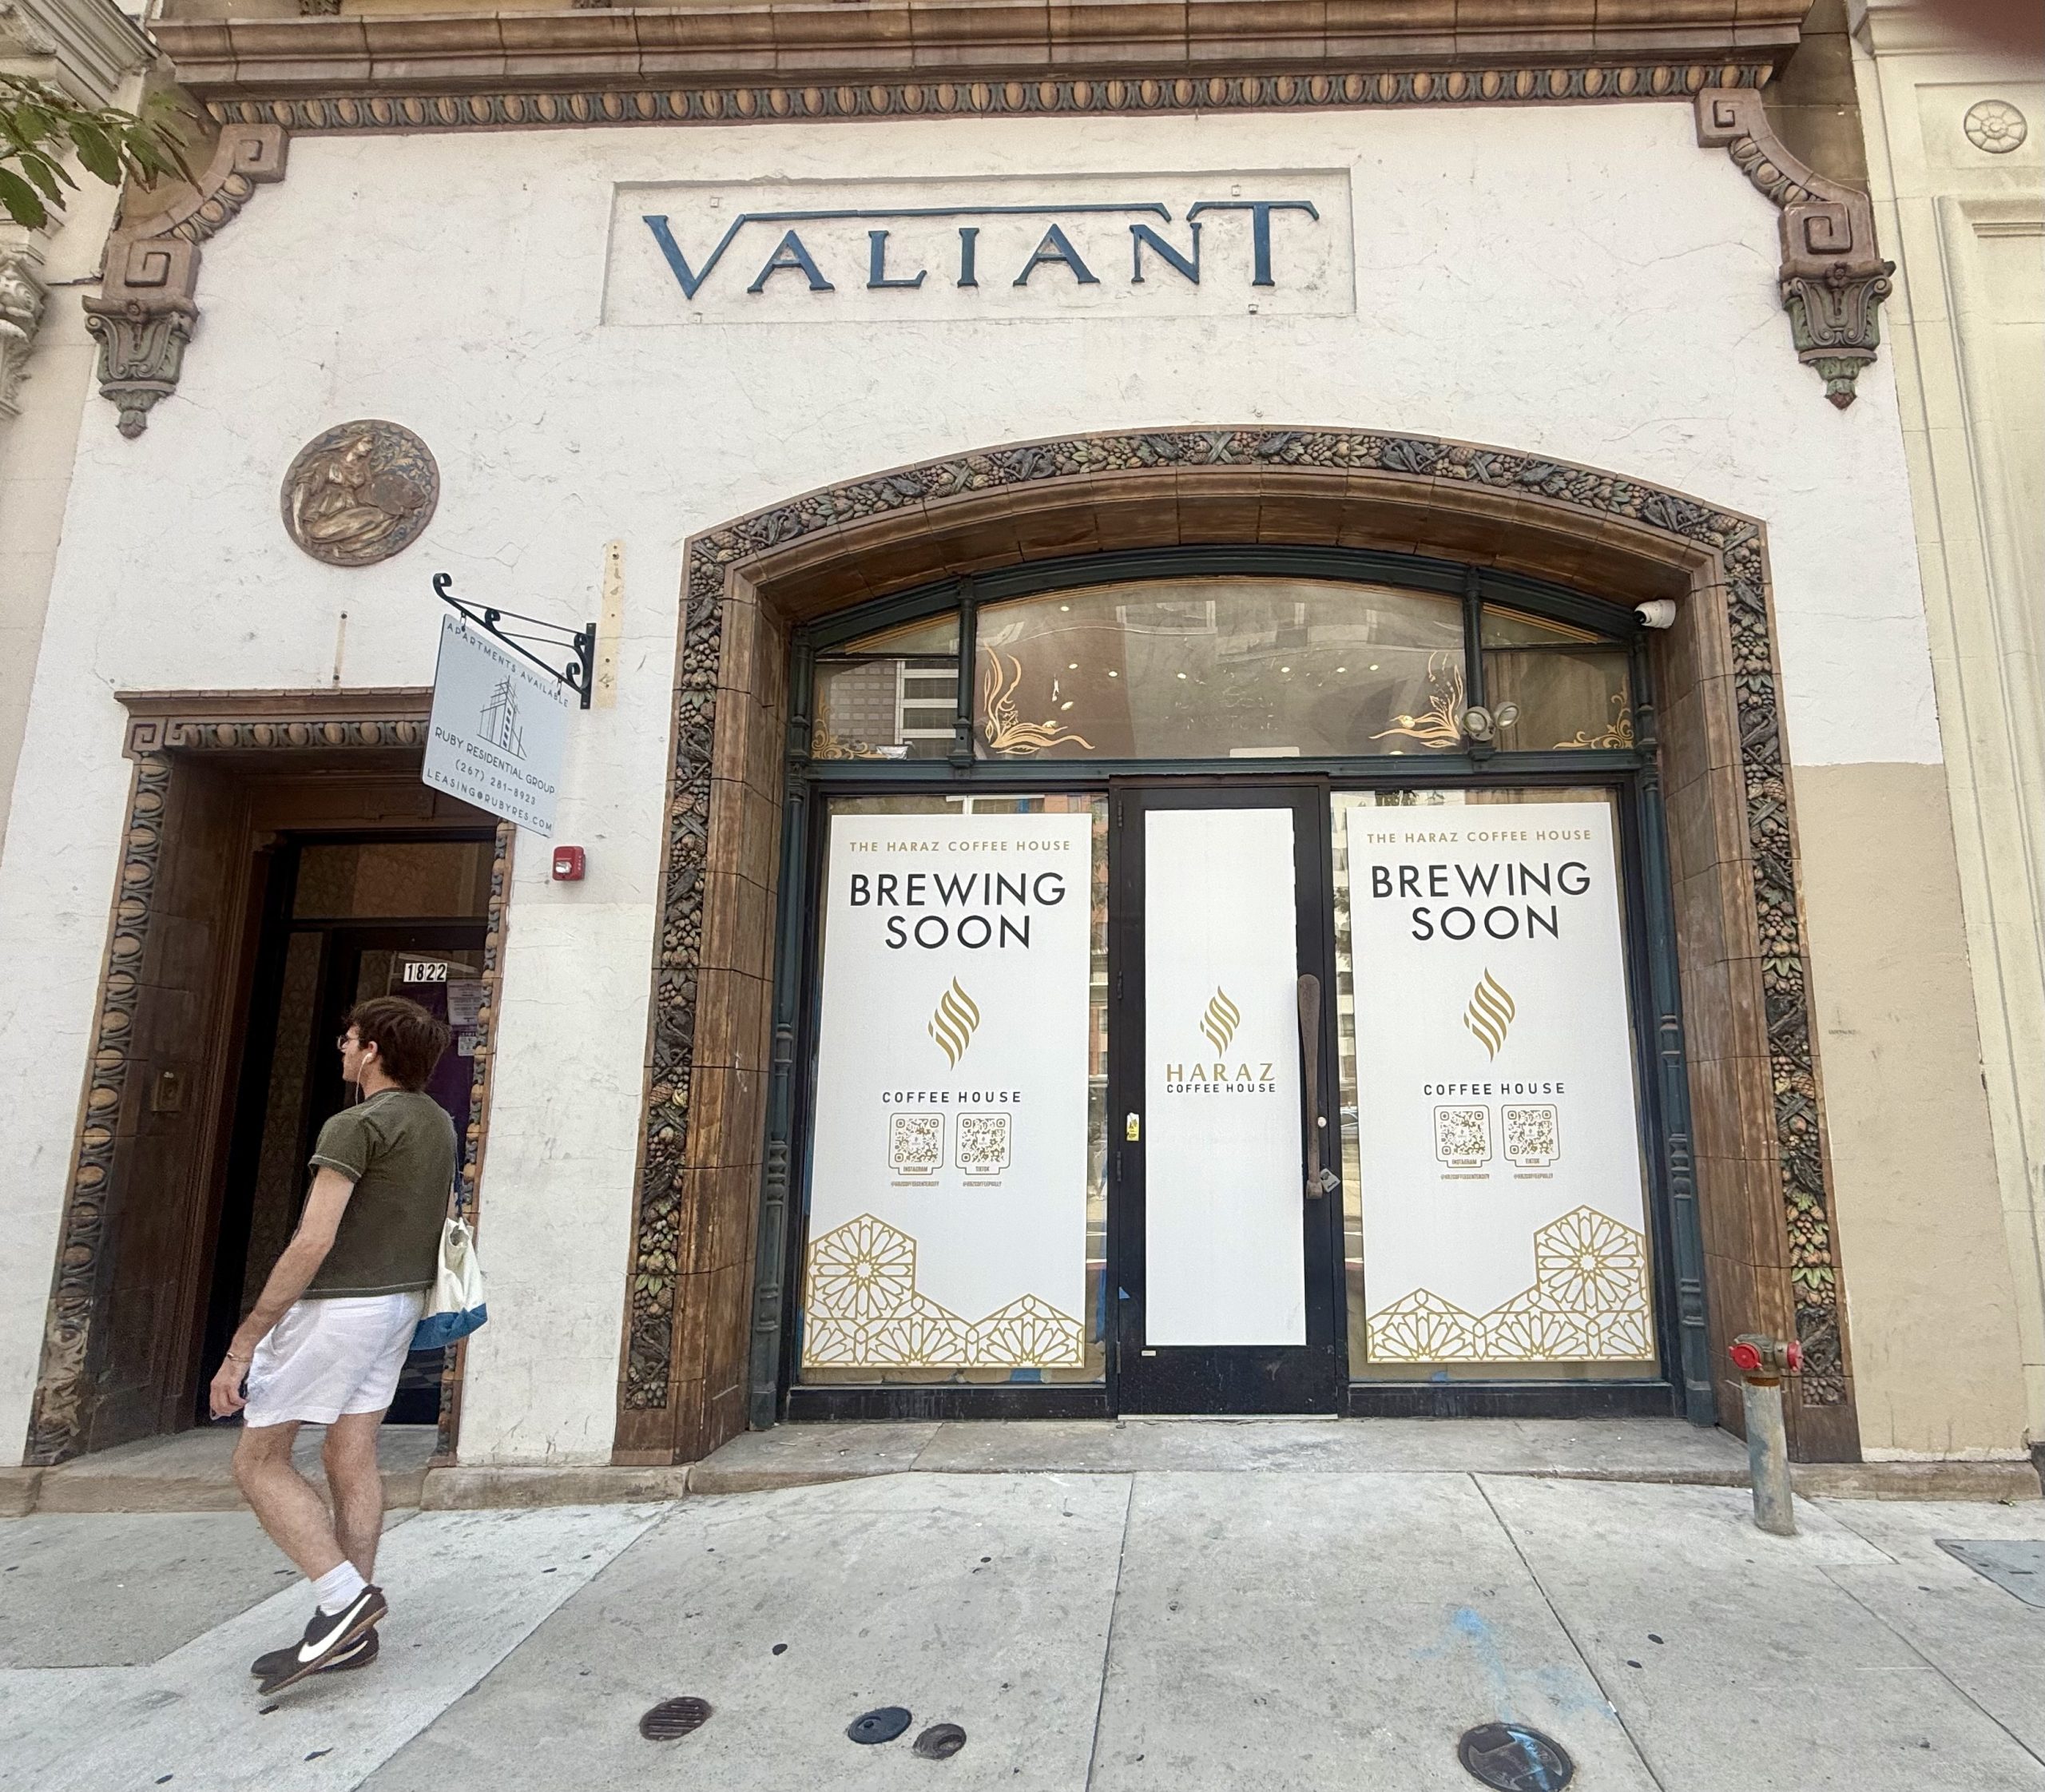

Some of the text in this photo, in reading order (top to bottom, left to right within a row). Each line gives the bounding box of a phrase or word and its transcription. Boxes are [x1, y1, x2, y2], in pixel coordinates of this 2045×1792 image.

[642, 201, 1320, 300] VALIANT
[447, 622, 569, 708] APARTMENTS AVAILABLE
[435, 727, 555, 794] RUBY RESIDENTIAL GROUP
[455, 759, 536, 805] (267) 281-8923
[850, 840, 1070, 852] THE HARAZ COFFEE HOUSE
[1368, 829, 1591, 844] THE HARAZ COFFEE HOUSE
[850, 872, 1066, 908] BREWING
[1372, 861, 1590, 899] BREWING
[884, 913, 1030, 950] SOON
[1412, 904, 1559, 941] SOON
[407, 964, 446, 981] 1822
[1166, 1063, 1276, 1083] HARAZ
[1166, 1083, 1277, 1094] COFFEE HOUSE
[1424, 1083, 1565, 1096] COFFEE HOUSE
[882, 1091, 1021, 1103] COFFEE HOUSE
